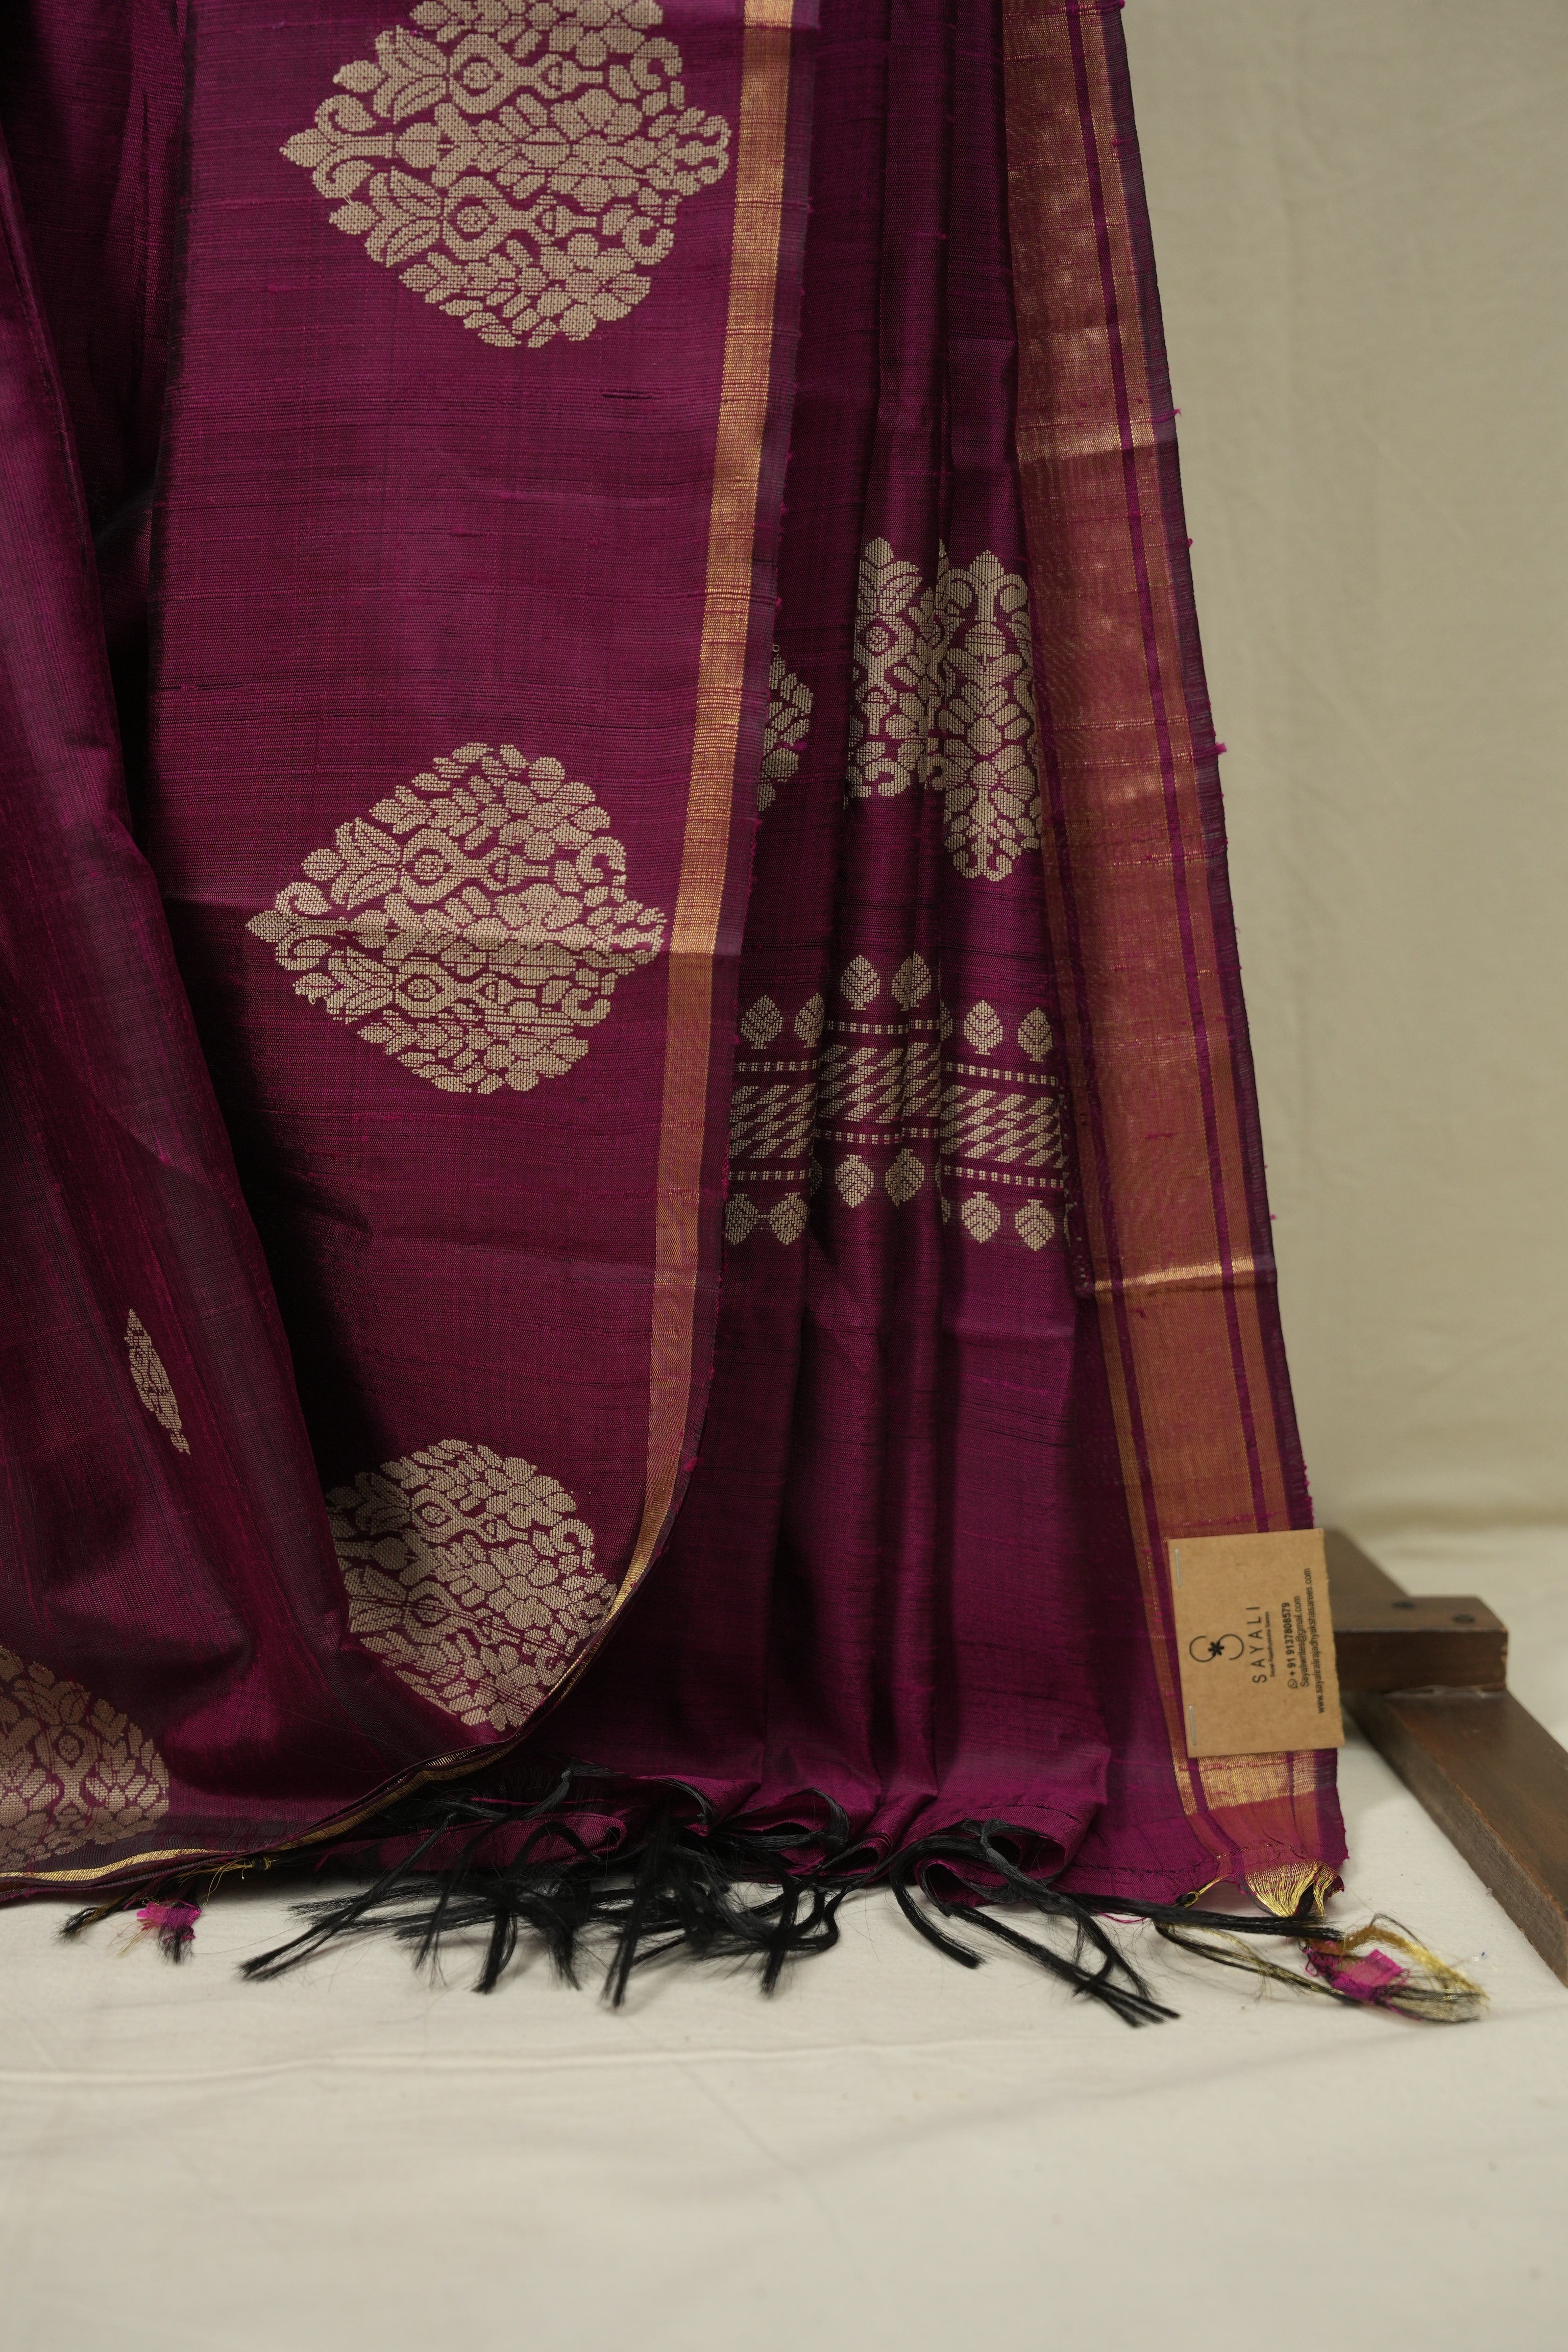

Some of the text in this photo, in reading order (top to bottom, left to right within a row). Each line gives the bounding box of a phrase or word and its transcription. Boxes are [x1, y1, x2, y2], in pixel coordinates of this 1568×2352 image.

[1245, 1607, 1267, 1683] SAYALI
[1281, 1602, 1294, 1655] 9137808579
[1286, 1658, 1296, 1668] 91
